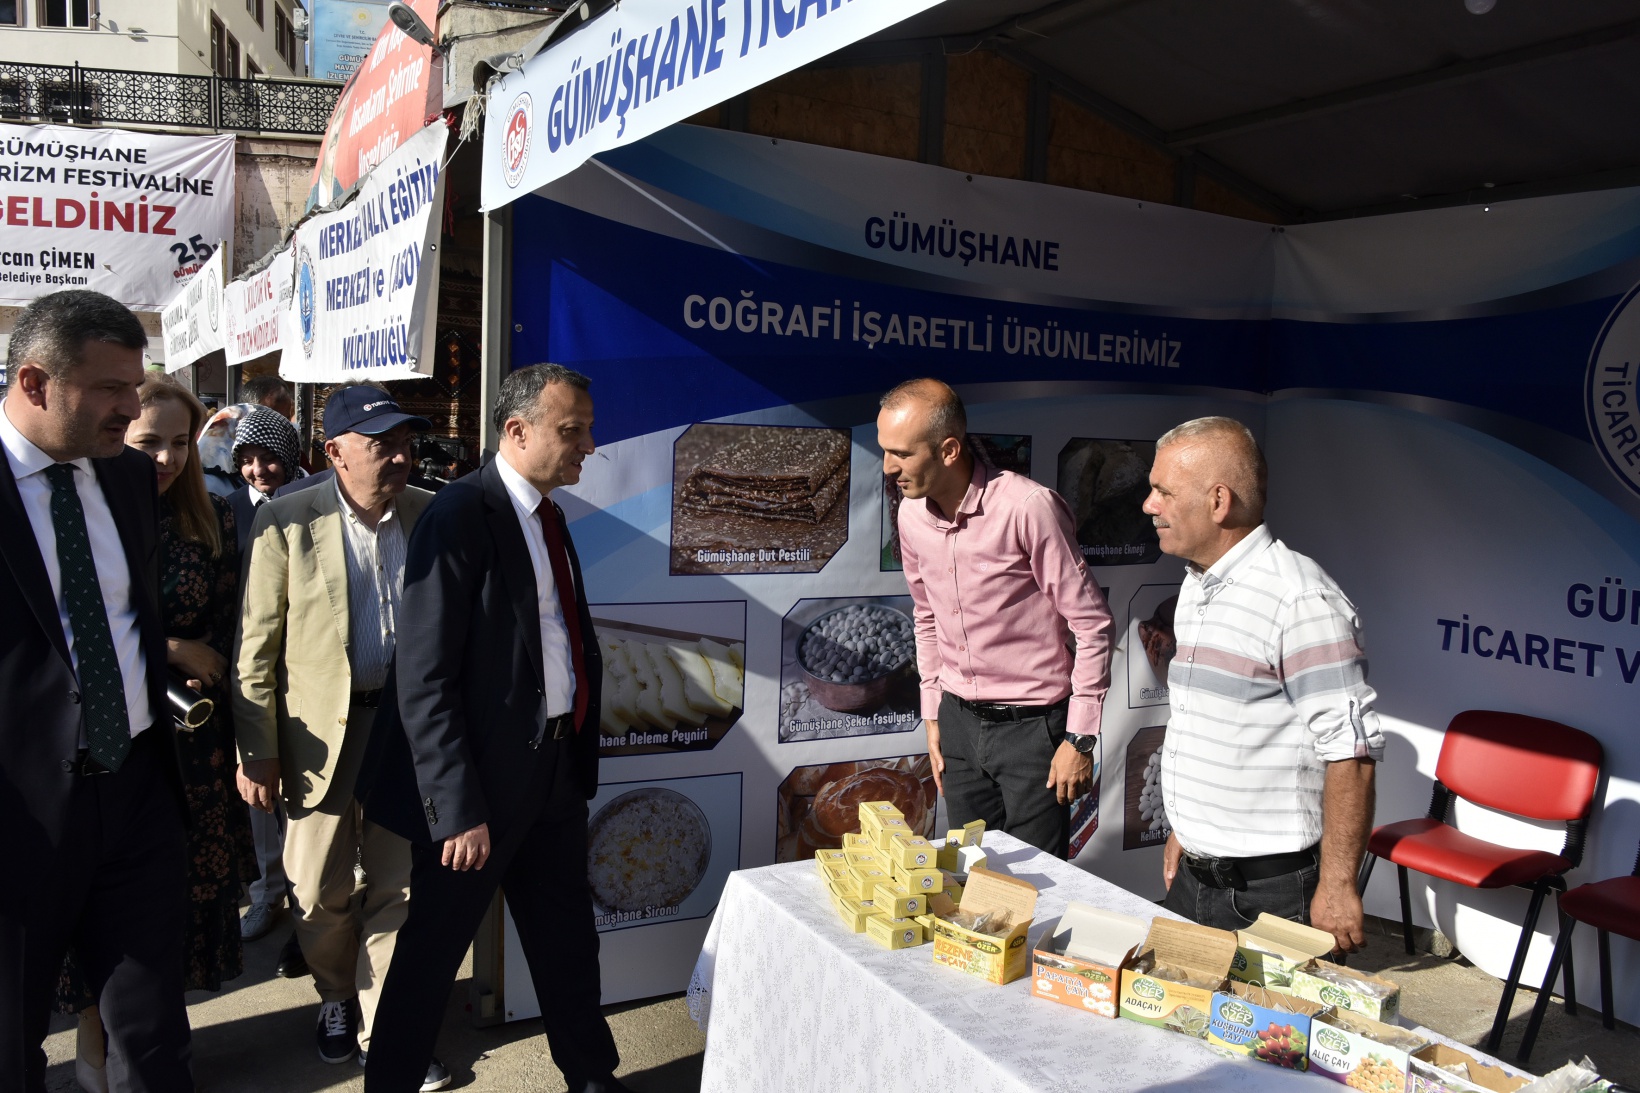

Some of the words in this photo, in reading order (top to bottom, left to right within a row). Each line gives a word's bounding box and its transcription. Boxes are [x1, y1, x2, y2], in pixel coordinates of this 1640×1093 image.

[334, 64, 355, 72] HAVA
[547, 7, 727, 154] GÜMÜŞHANE
[63, 168, 214, 197] FESTİVALİNE
[0, 191, 176, 236] ELDİNİZ
[319, 217, 362, 260] MERKEZ
[865, 211, 1059, 271] GÜMÜŞHANE
[0, 252, 34, 267] can
[40, 247, 95, 270] ÇİMEN
[0, 271, 41, 285] elediye
[45, 273, 88, 286] Başkanı
[326, 258, 370, 311] MERKEZİ
[683, 289, 841, 341] COĞRAFİ
[853, 300, 993, 352] İŞARETLİ
[1002, 316, 1182, 369] ÜRÜNLERİMİZ
[341, 314, 407, 370] MÜDÜRLÜĞÜ
[1602, 361, 1640, 476] TİCARE
[697, 549, 756, 565] Gümüşhane
[758, 548, 776, 561] Dut
[778, 548, 810, 561] Pestili
[1124, 543, 1146, 556] Ekmeği
[1437, 614, 1605, 677] TİCARET
[789, 718, 843, 734] Gümüşhane
[845, 715, 871, 731] Şeker
[873, 710, 915, 726] Fasülyesi
[629, 731, 669, 746] Deleme
[671, 727, 708, 745] Peyniri
[1140, 829, 1161, 842] Kelkit
[645, 905, 679, 918] Sironu
[935, 938, 973, 962] REZENE
[976, 941, 996, 953] ÖZER
[947, 954, 967, 970] ÇAYI
[1036, 965, 1083, 988] PAPATYA
[1084, 971, 1106, 982] ÖZER
[1065, 984, 1089, 998] ÇAYI
[1134, 983, 1164, 999] ÖZER
[1125, 997, 1162, 1013] ADAÇAYI
[1221, 1008, 1253, 1025] ÖZER
[1211, 1018, 1258, 1040] KUŞBURNU
[1222, 1030, 1243, 1043] ÇAYI
[1318, 1033, 1349, 1054] ÖZER
[1312, 1049, 1330, 1065] ALIÇ
[1331, 1056, 1350, 1070] ÇAYI
